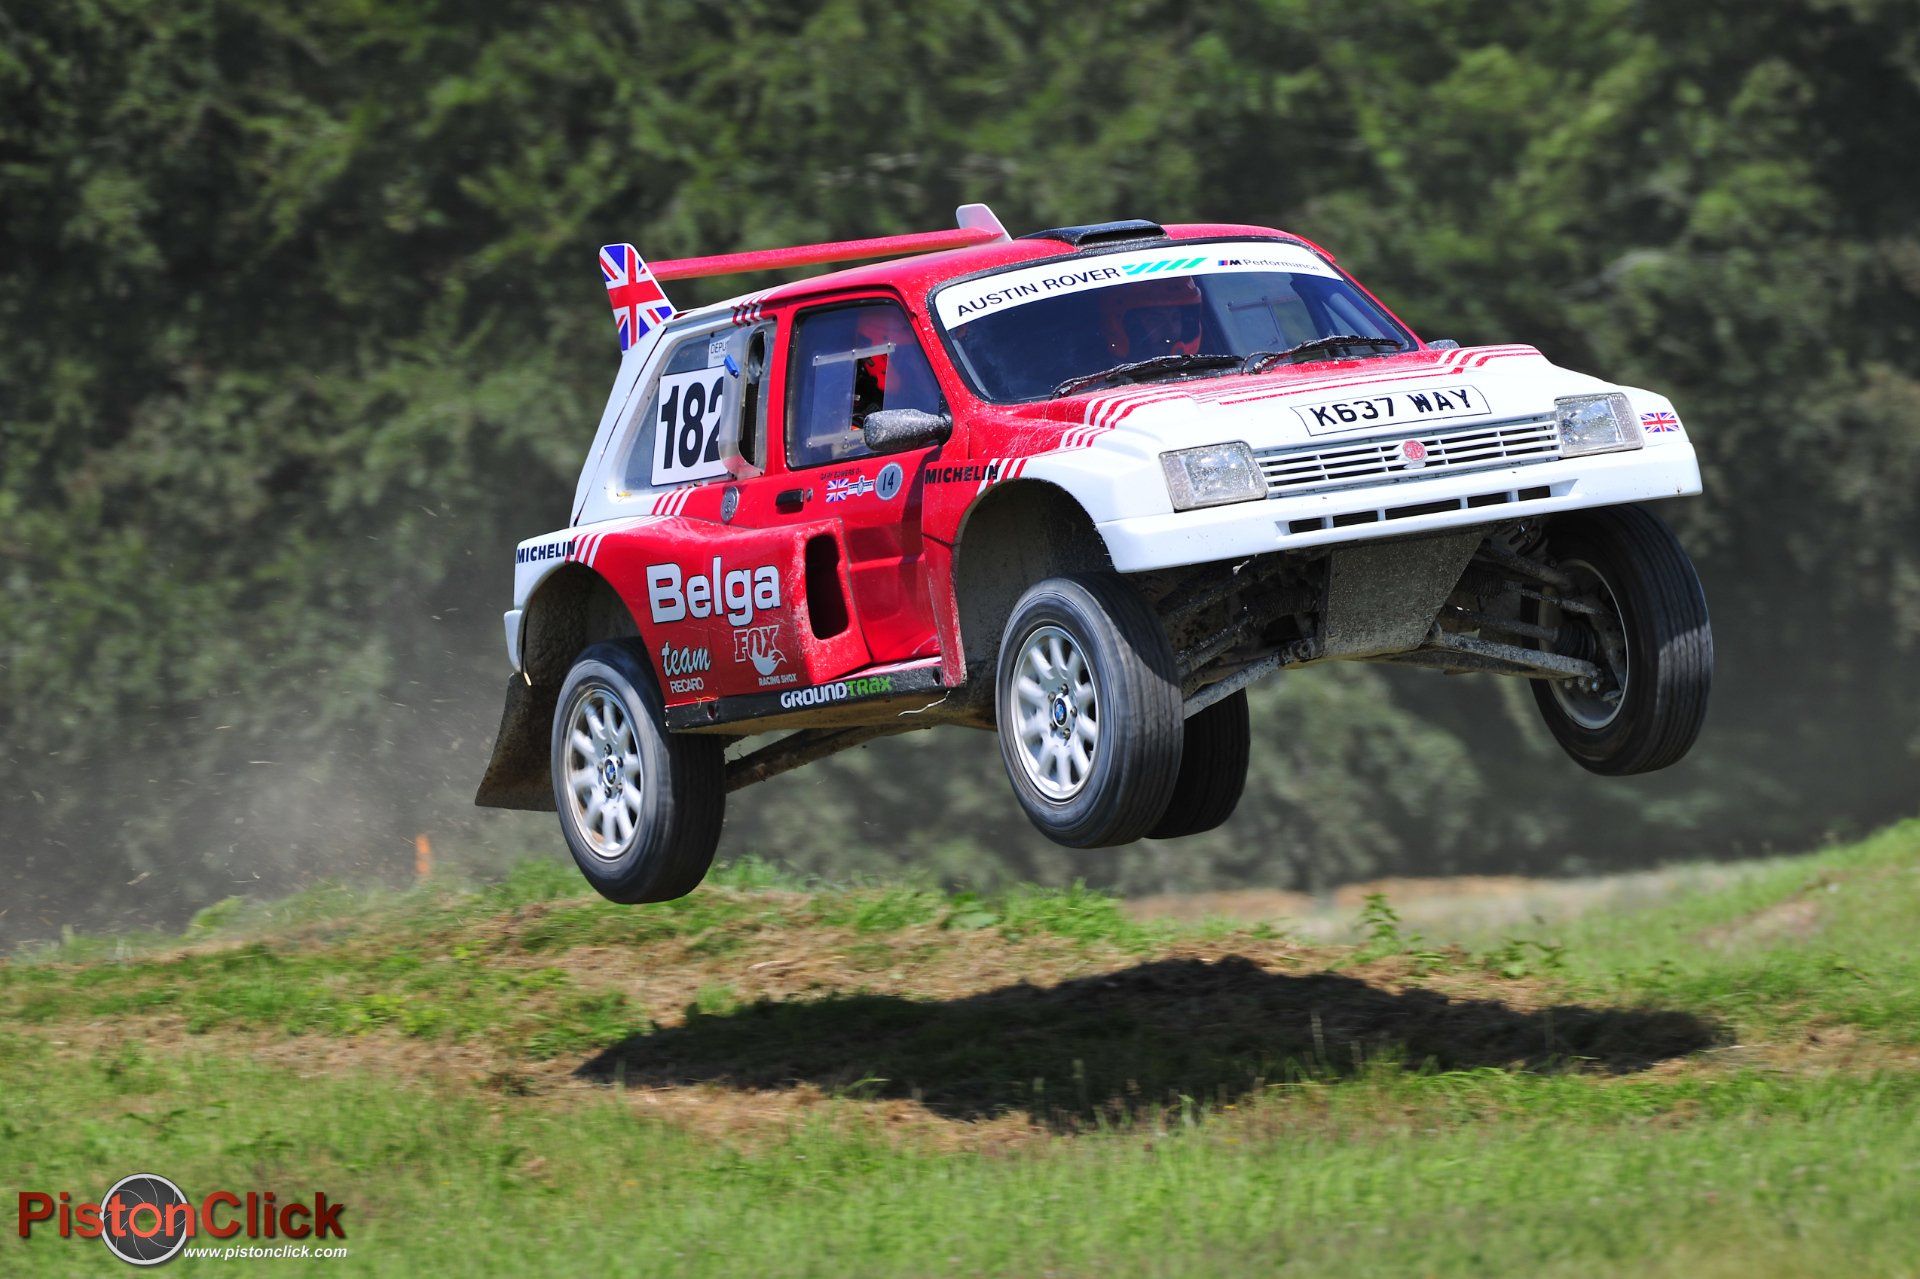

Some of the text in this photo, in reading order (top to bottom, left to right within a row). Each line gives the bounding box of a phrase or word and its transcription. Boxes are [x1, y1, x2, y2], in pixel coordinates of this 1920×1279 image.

[1244, 258, 1320, 272] Performance
[957, 266, 1121, 317] AUSTIN ROVER
[1307, 387, 1475, 428] K637 WAY
[882, 471, 895, 491] 14
[924, 464, 1000, 485] MICHELIN
[516, 540, 576, 564] MICHELIN
[645, 555, 782, 627] Belga
[661, 640, 711, 677] team
[733, 624, 780, 663] FOX
[669, 676, 705, 693] RECARO
